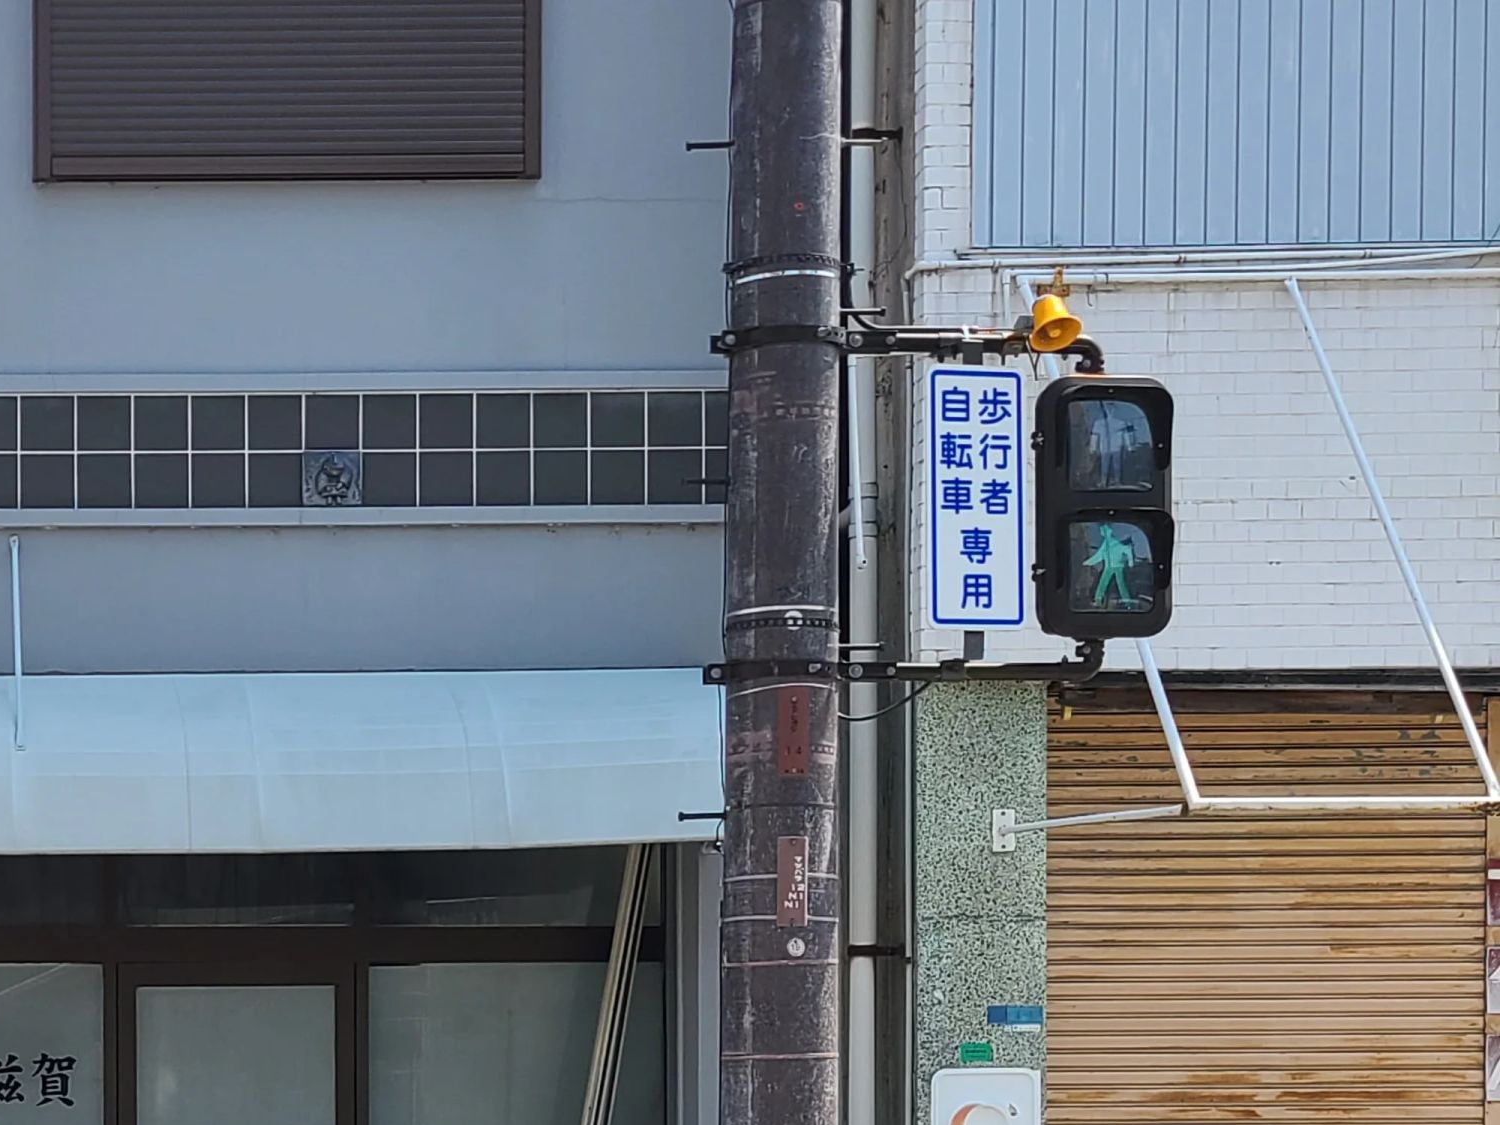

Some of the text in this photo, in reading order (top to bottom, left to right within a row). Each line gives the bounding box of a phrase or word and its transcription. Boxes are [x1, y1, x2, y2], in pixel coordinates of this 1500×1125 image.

[939, 386, 974, 515] 自転車
[978, 386, 1013, 516] 歩行者
[959, 526, 994, 610] 専用
